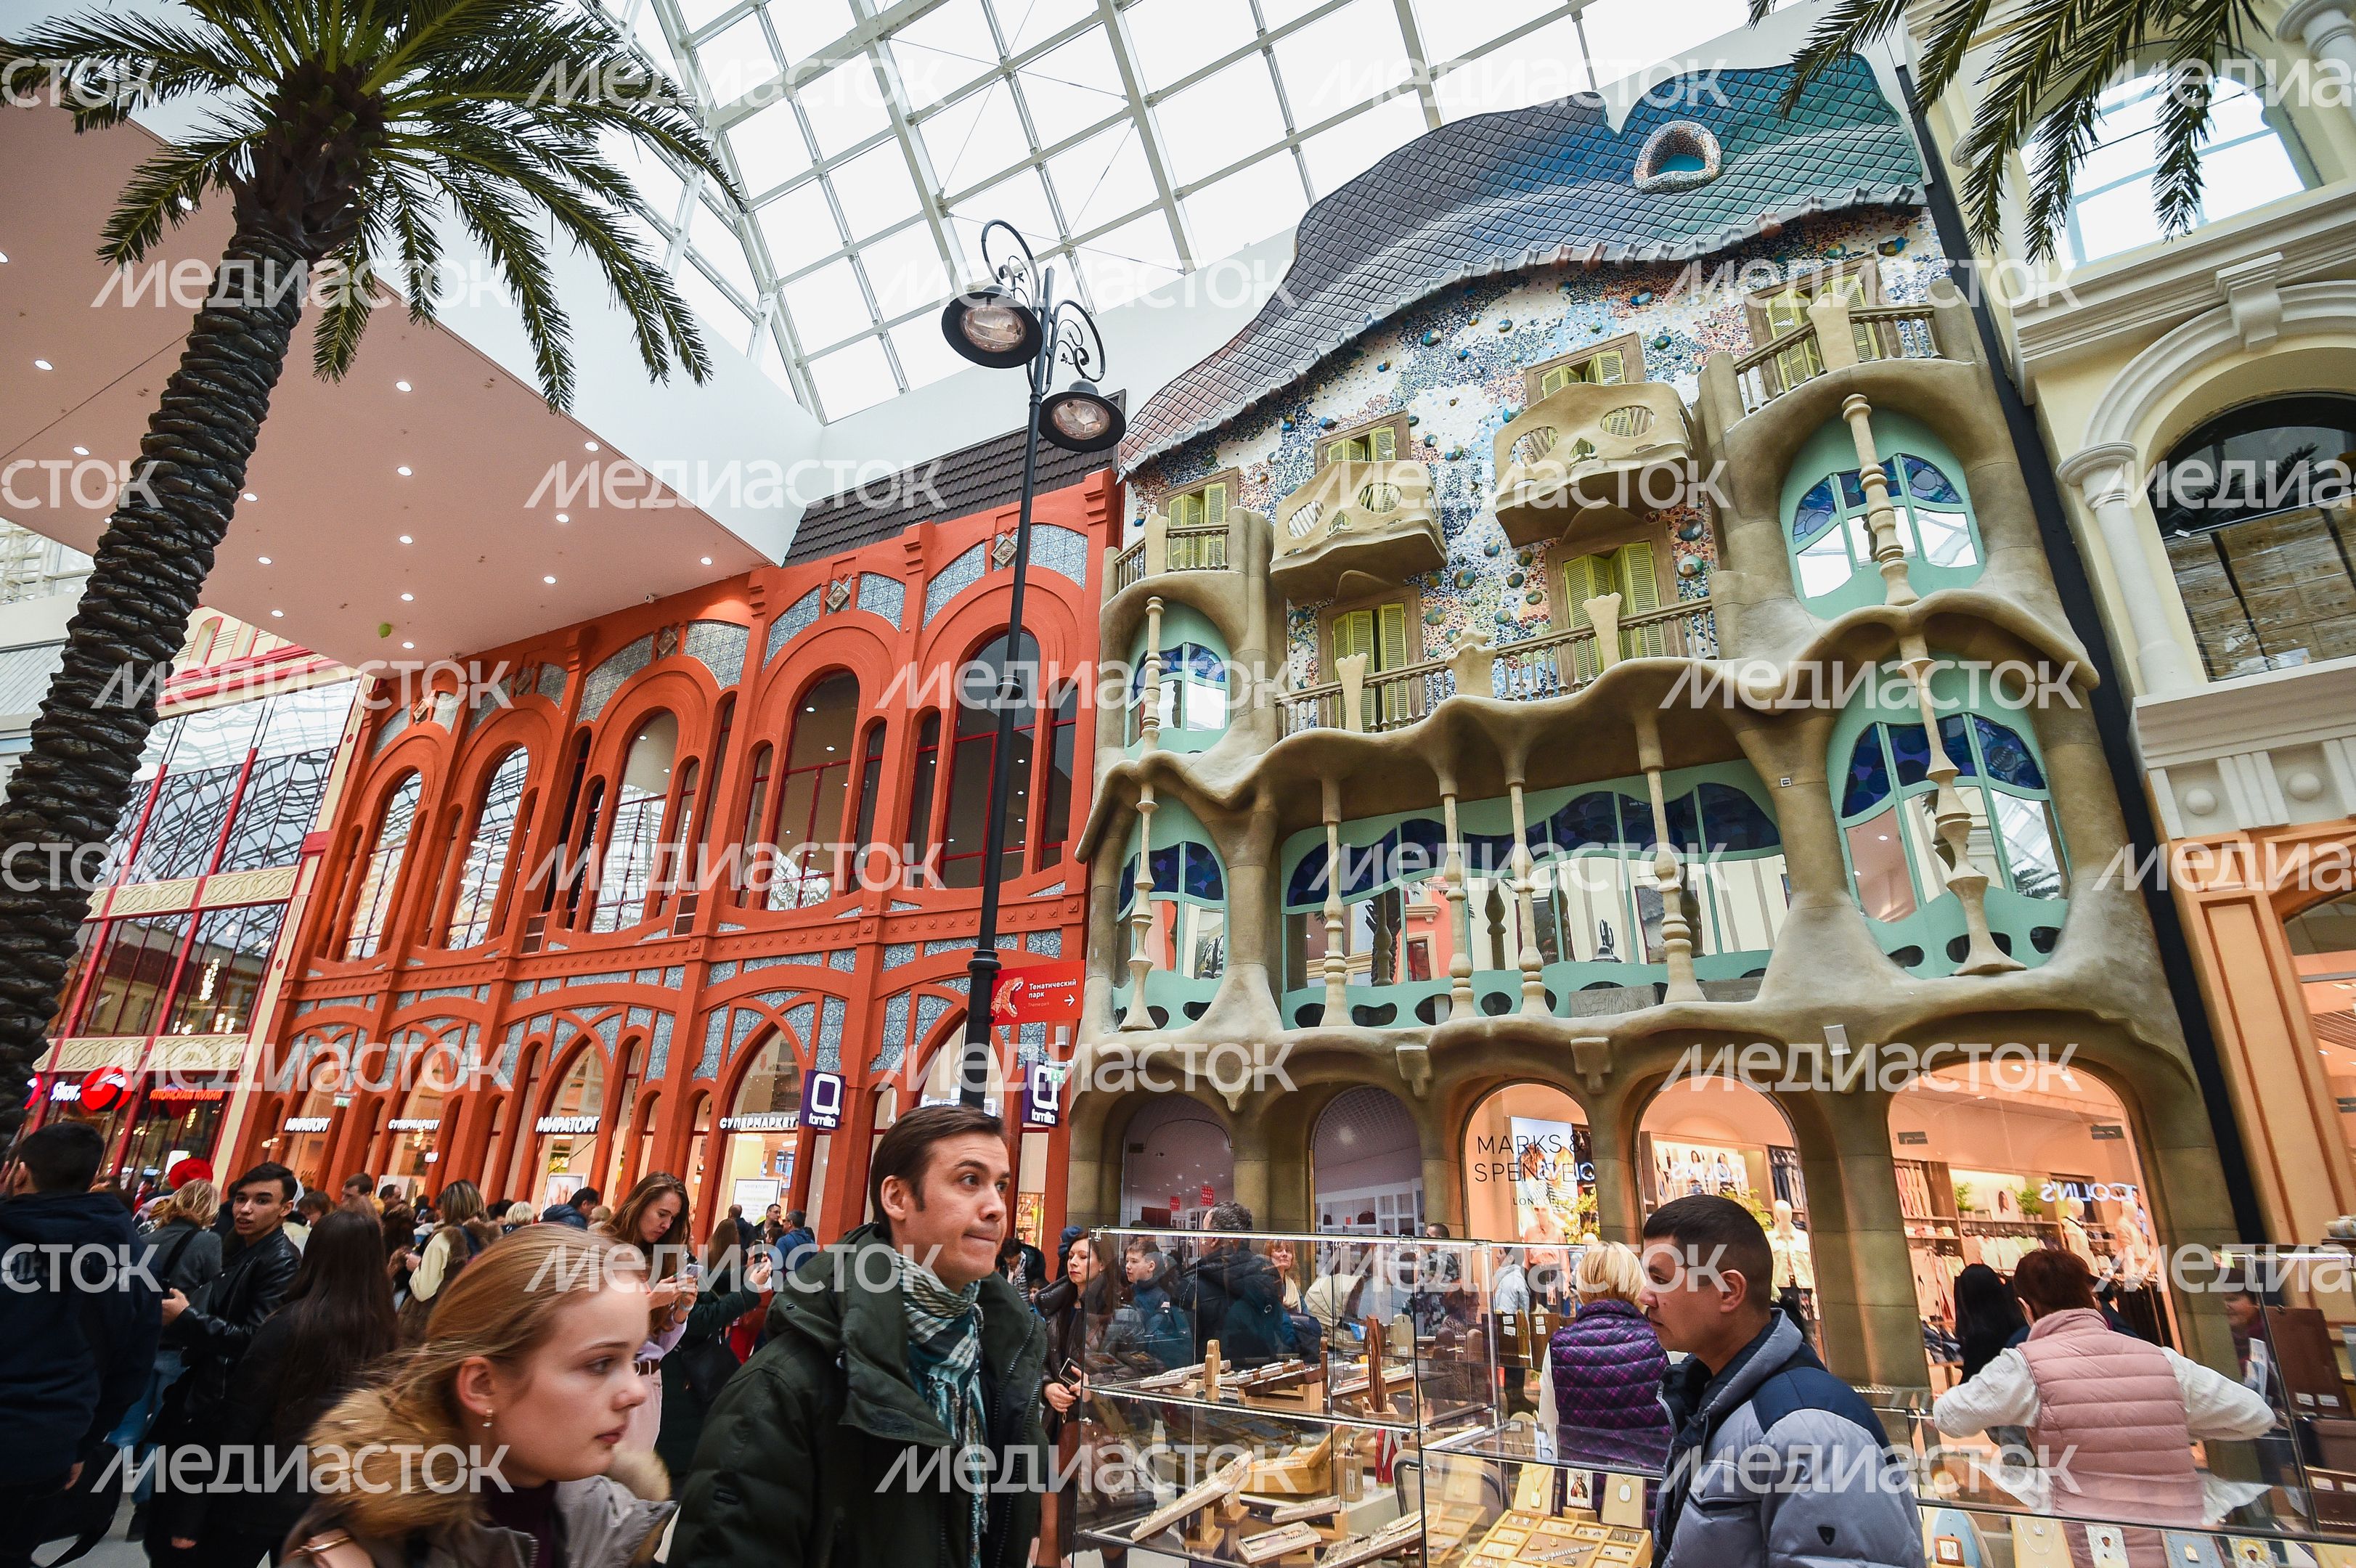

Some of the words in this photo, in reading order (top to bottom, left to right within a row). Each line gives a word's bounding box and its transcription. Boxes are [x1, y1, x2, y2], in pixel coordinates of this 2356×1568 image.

[1029, 978, 1077, 990] Тематический
[535, 1116, 600, 1132] МИРАТОРГ
[719, 1116, 796, 1129] СУПЕРМАРКЕТ
[1477, 1134, 1562, 1154] MARKS
[1570, 1135, 1585, 1153] &
[1475, 1162, 1593, 1183] SPENCE
